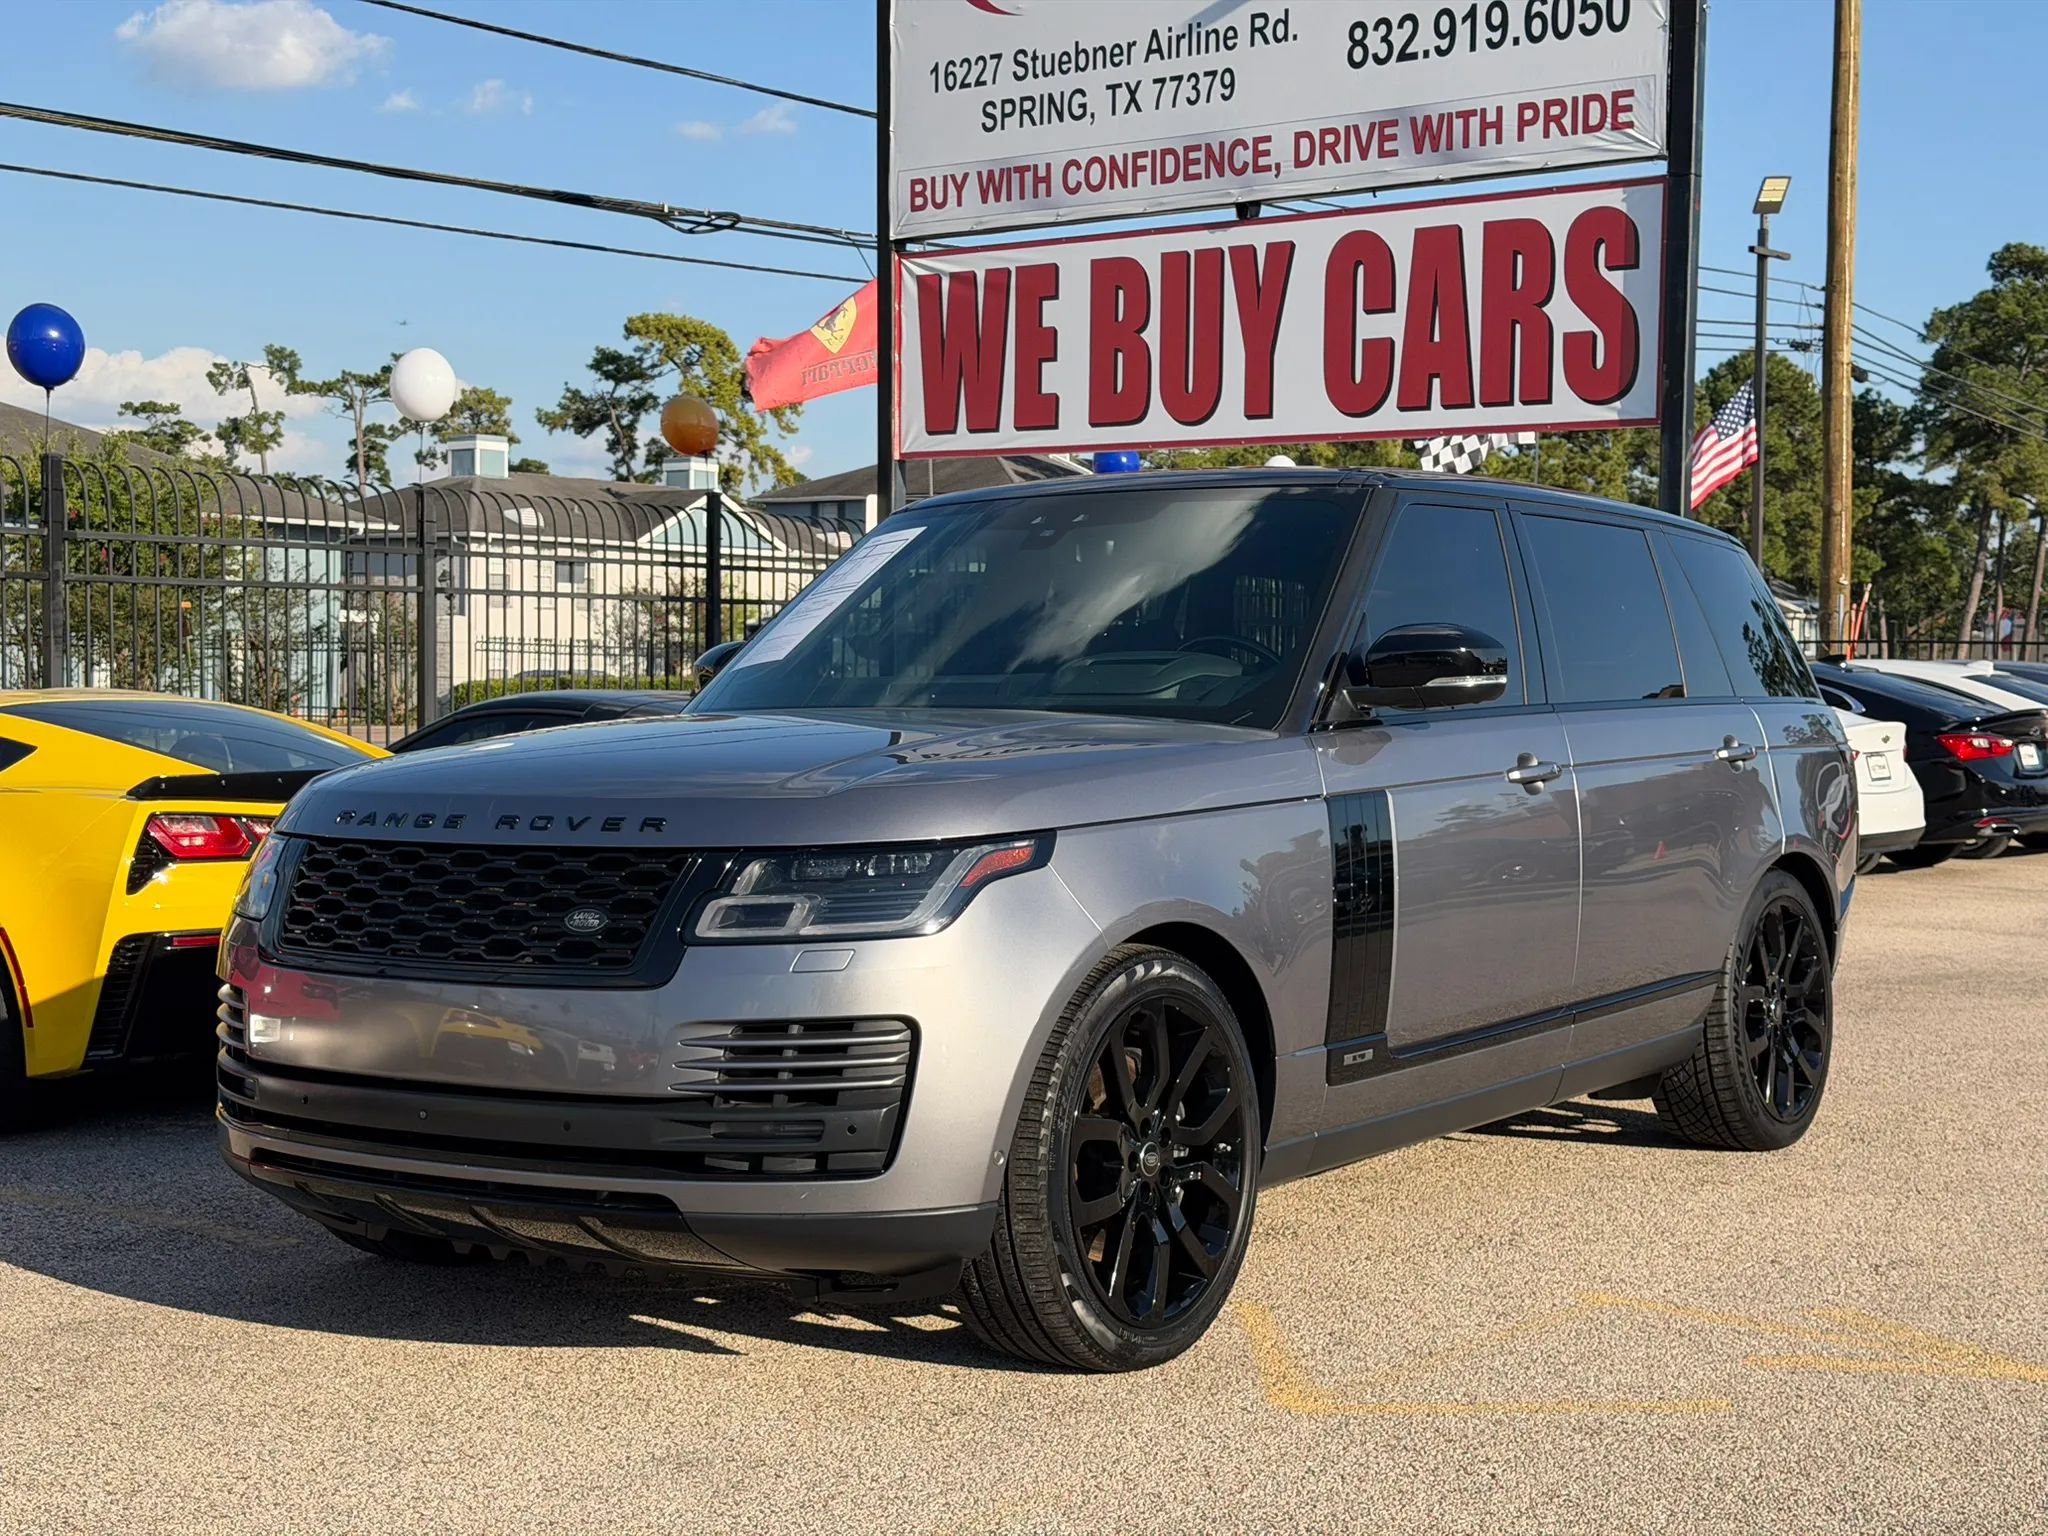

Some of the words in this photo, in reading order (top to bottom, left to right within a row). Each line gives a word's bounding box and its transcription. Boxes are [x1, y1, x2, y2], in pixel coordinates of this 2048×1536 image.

[930, 53, 1003, 94] 16227
[1012, 40, 1137, 82] Stuebner
[1144, 23, 1239, 64] Airline
[1250, 8, 1298, 48] Rd.
[1347, 0, 1631, 69] 832.919.6050
[980, 88, 1096, 134] SPRING,
[1106, 80, 1143, 116] TX
[1152, 67, 1236, 111] 77379
[909, 172, 969, 213] BUY
[977, 162, 1052, 205] WITH
[1061, 135, 1281, 196] CONFIDENCE,
[1293, 119, 1399, 169] DRIVE
[1409, 105, 1503, 156] WITH
[1517, 89, 1635, 142] PRIDE
[916, 264, 1060, 435] WE
[1088, 240, 1296, 428] BUY
[1323, 206, 1640, 418] CARS
[334, 809, 467, 830] RANGE
[495, 814, 668, 833] ROVER
[573, 912, 595, 920] LAND
[573, 919, 600, 927] ROVER
